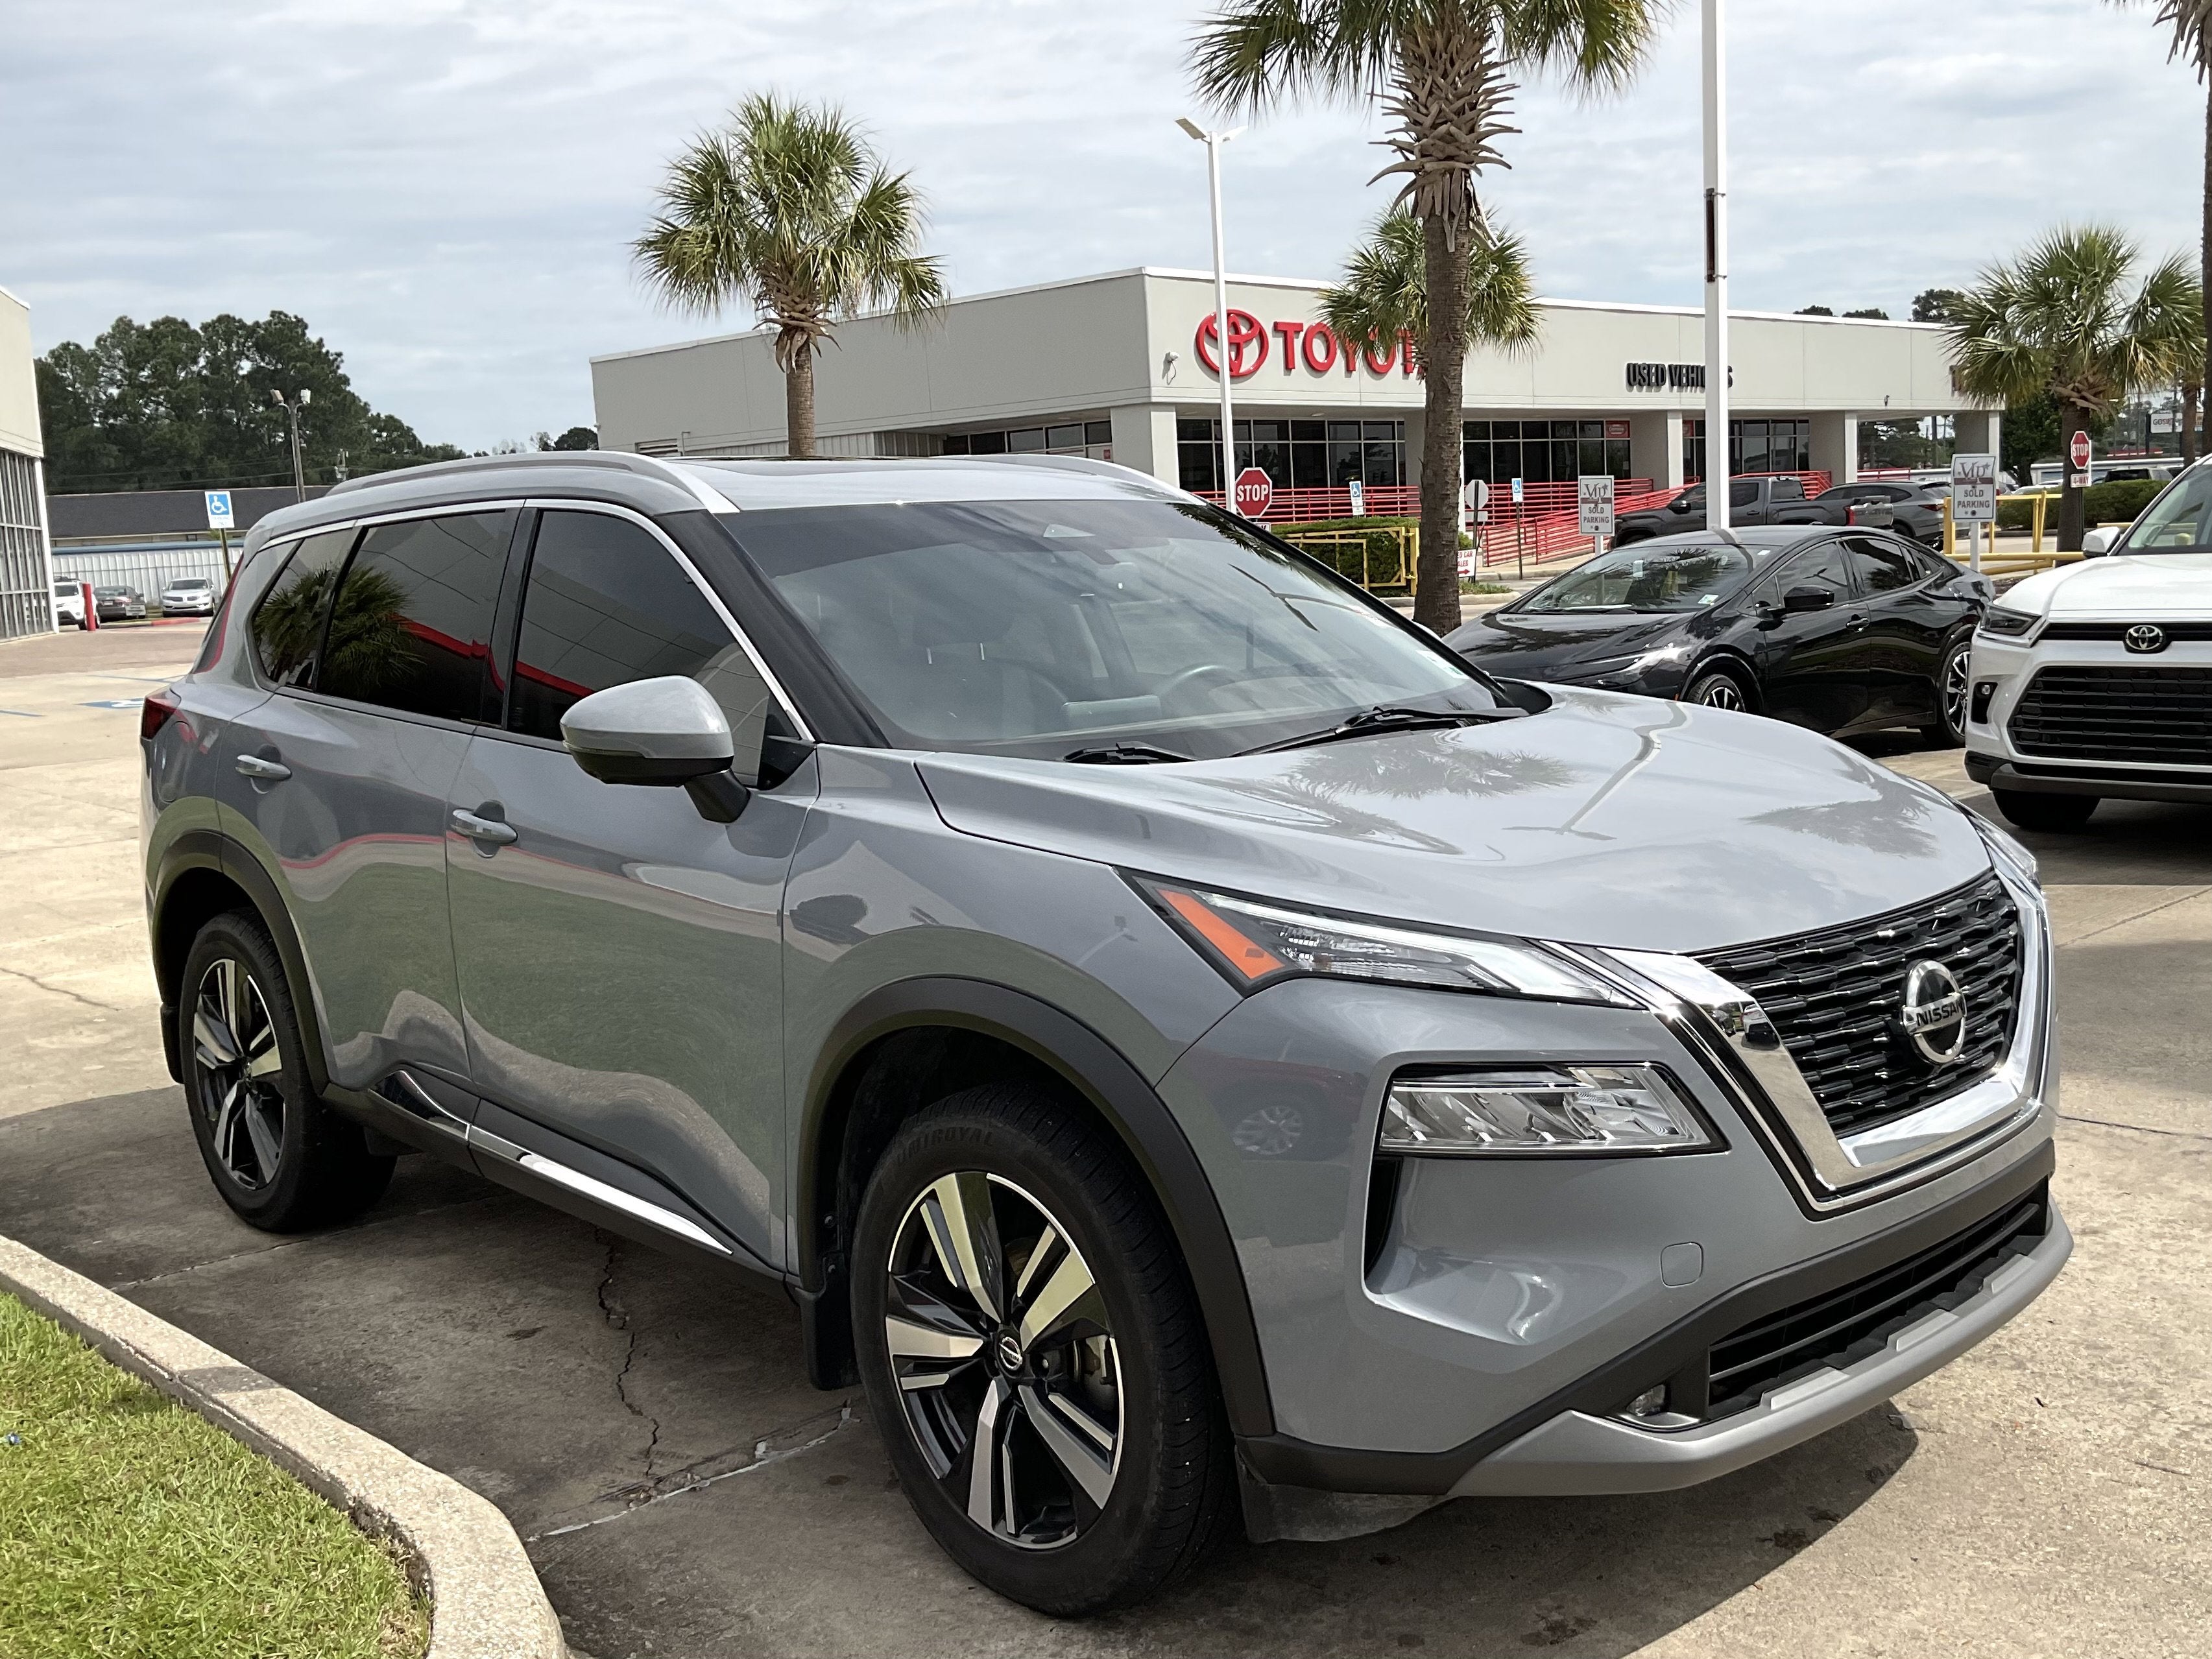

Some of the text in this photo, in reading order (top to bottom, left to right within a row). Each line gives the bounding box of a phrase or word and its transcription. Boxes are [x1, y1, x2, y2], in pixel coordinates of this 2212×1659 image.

[1274, 320, 1422, 374] TOYOT
[1626, 363, 1666, 387] USED
[2073, 443, 2089, 457] STOP
[1236, 484, 1269, 502] STOP
[1964, 489, 1984, 497] SOLD
[1957, 500, 1990, 508] PARKING
[1916, 1001, 1965, 1026] NISSAN
